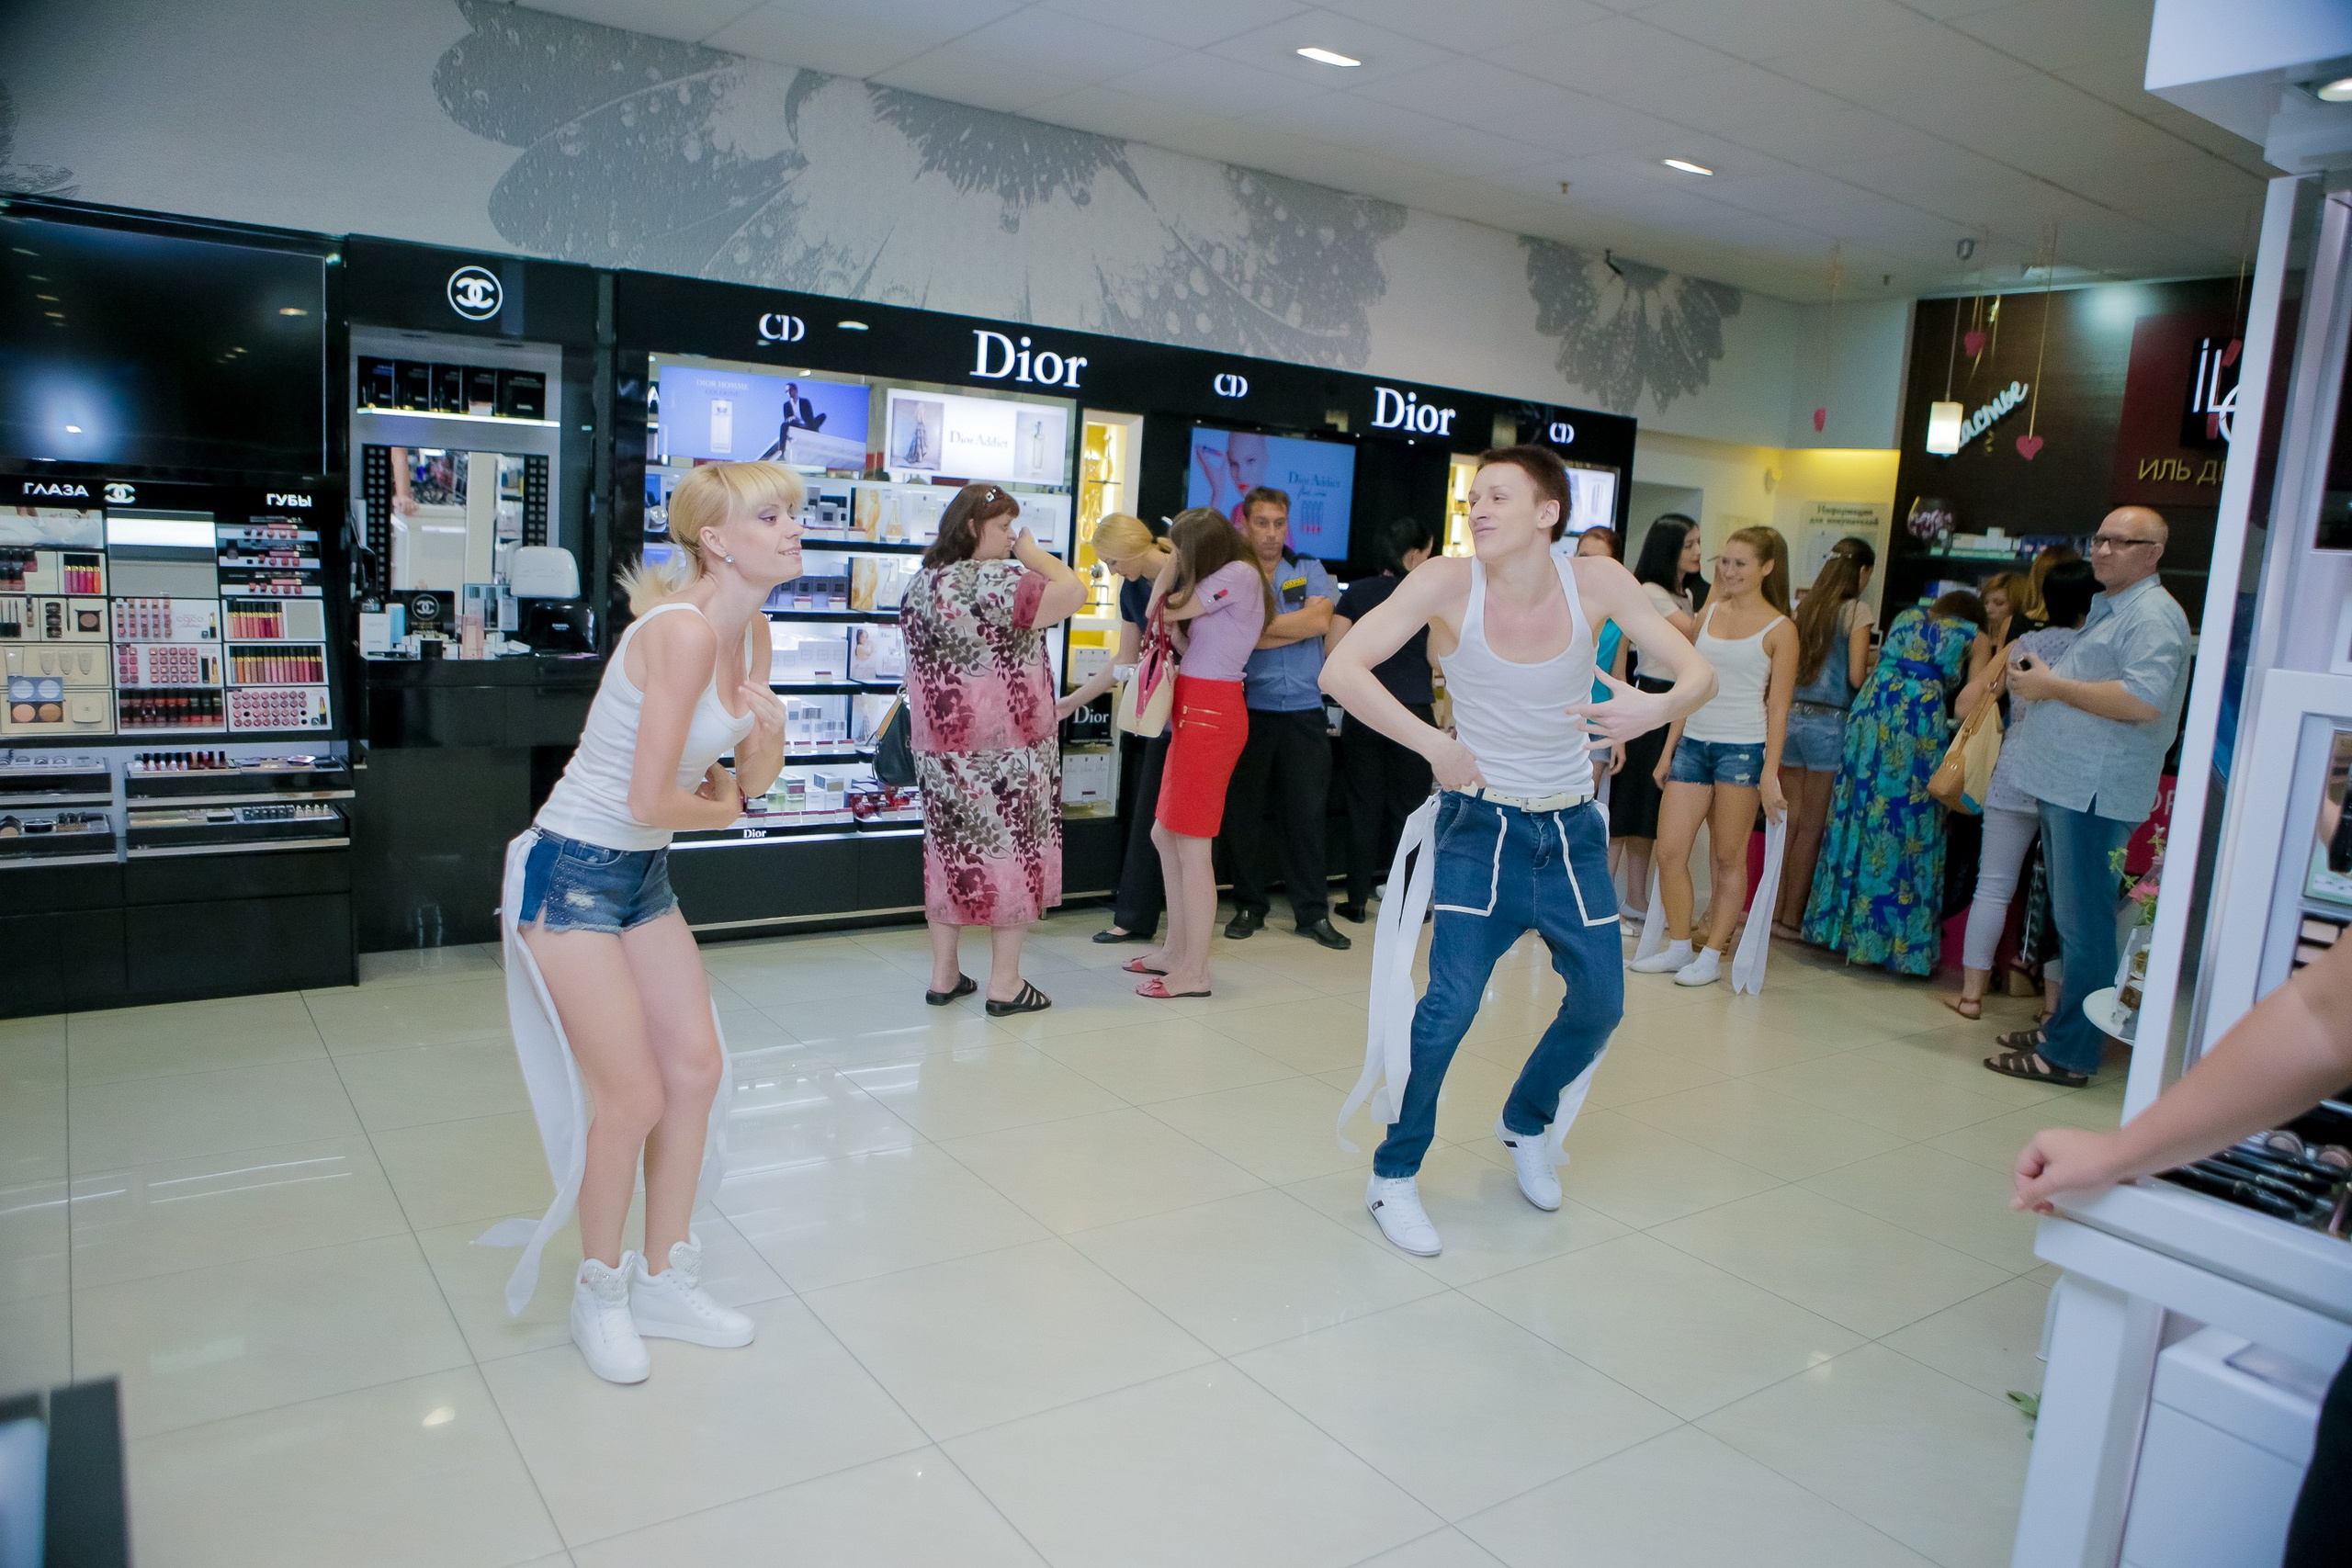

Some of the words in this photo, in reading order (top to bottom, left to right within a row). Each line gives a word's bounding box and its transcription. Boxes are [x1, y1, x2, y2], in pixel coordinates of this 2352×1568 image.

[969, 330, 1088, 388] Dior
[1371, 387, 1456, 435] Dior
[1959, 380, 2029, 449] астье
[950, 430, 973, 445] Dior
[975, 434, 1008, 448] Addict
[1288, 470, 1309, 484] Dior
[2138, 458, 2191, 481] ИЛЬ
[23, 482, 89, 497] ГЛАЗА
[266, 492, 312, 507] ГУБЫ
[1073, 705, 1109, 724] Dior
[743, 829, 767, 838] Dior
